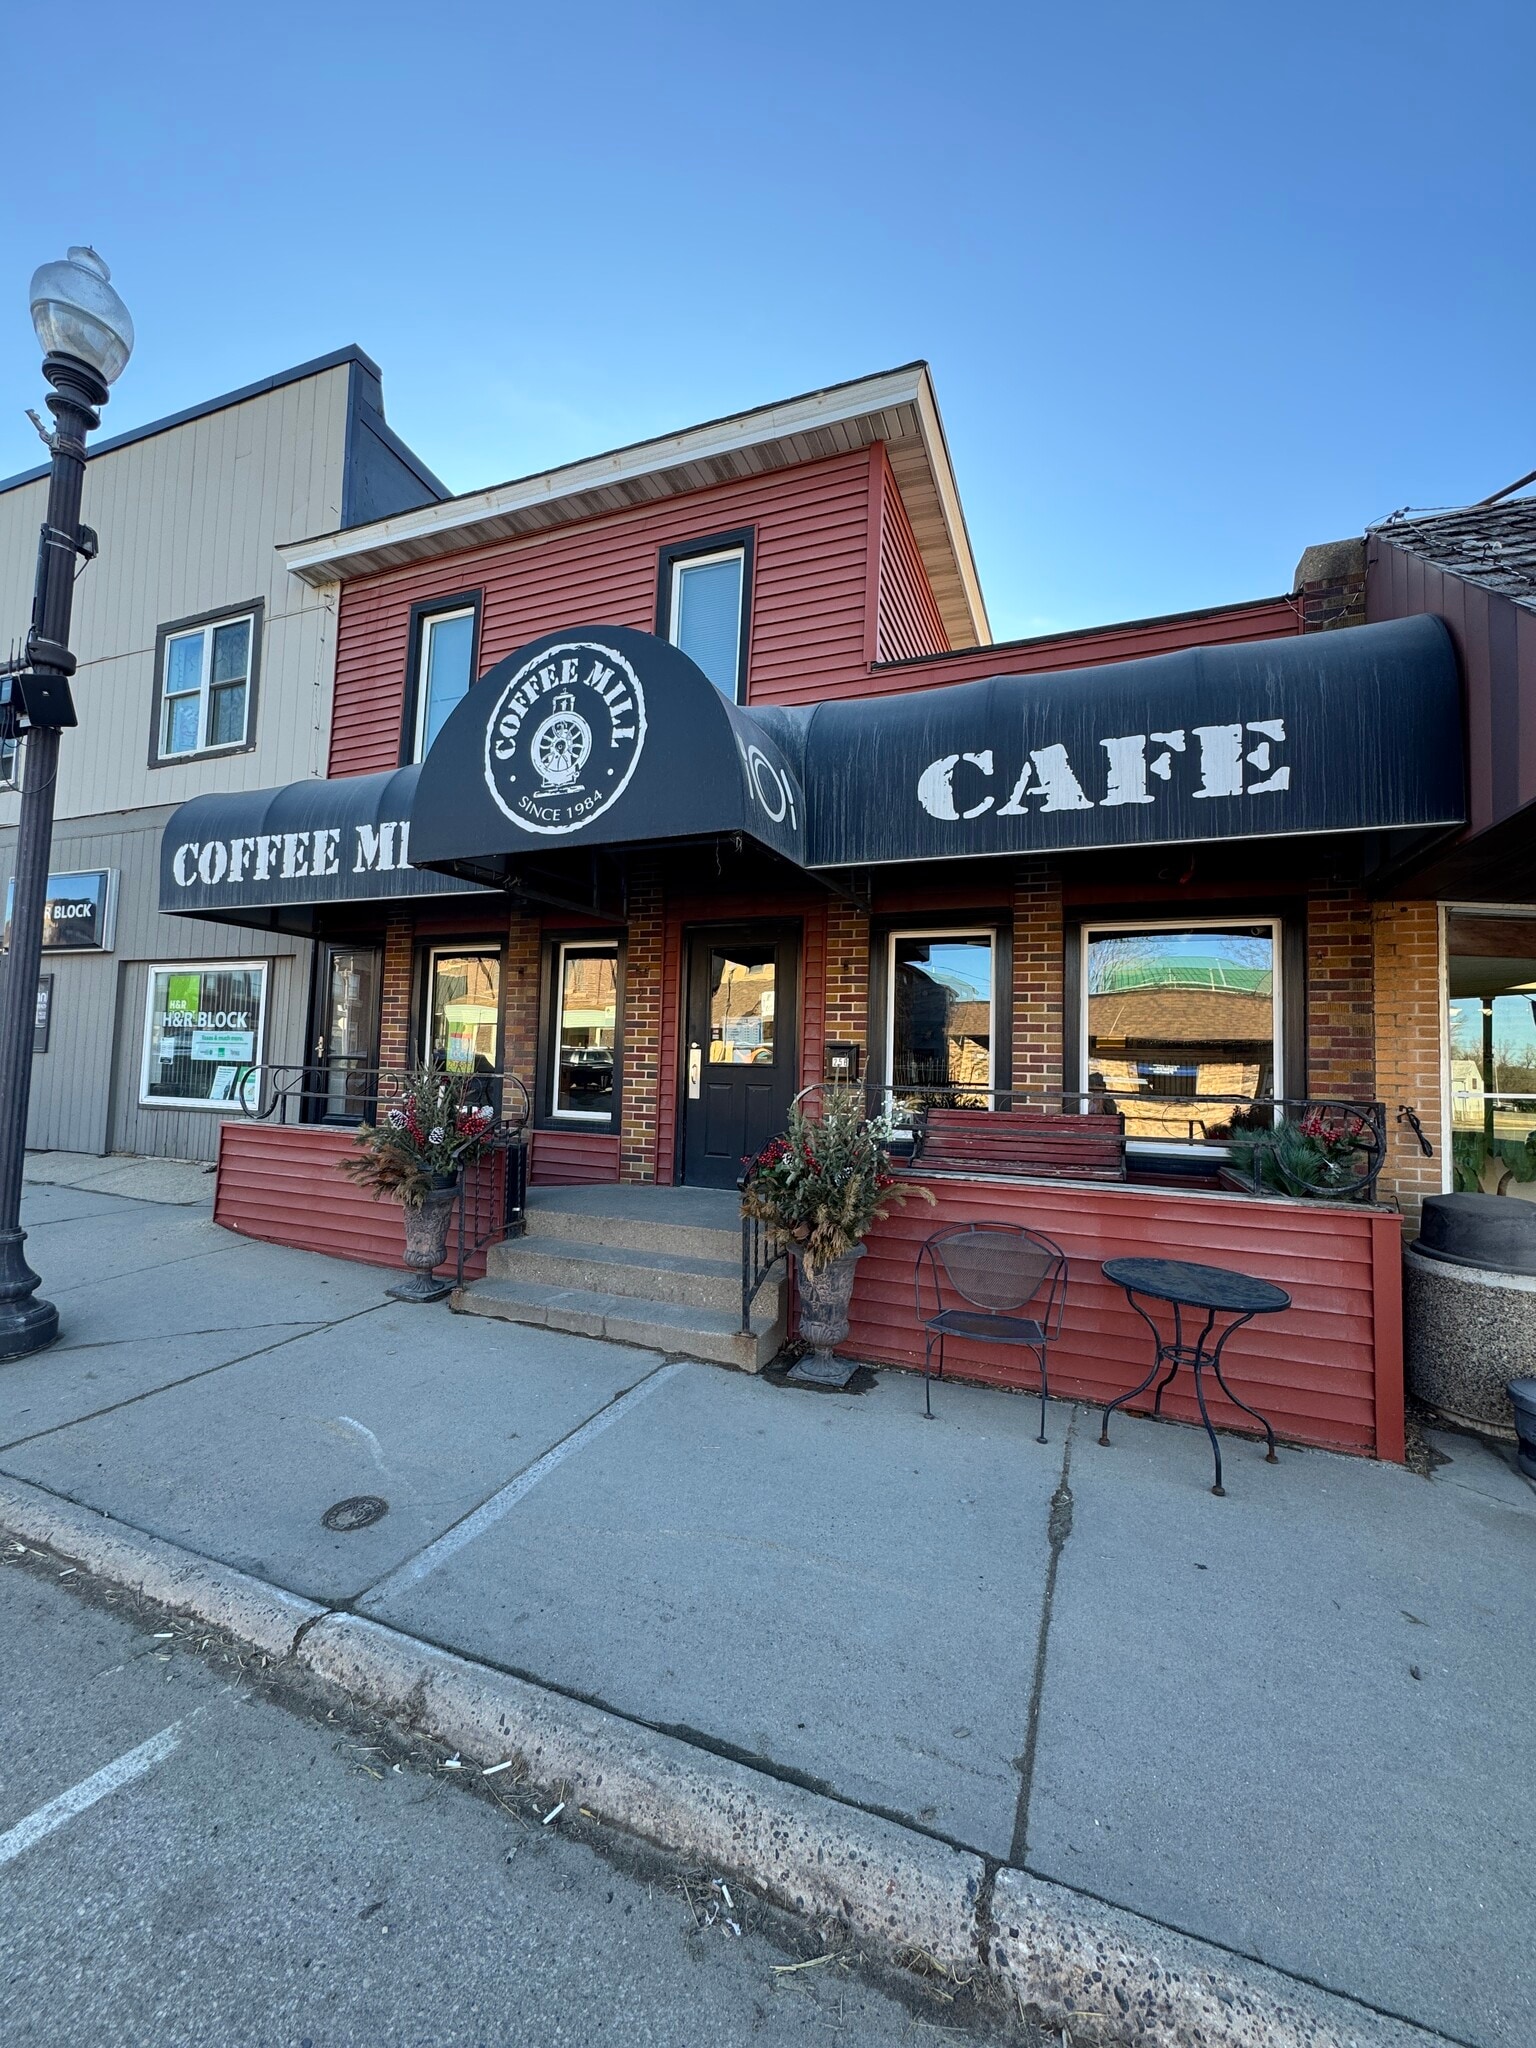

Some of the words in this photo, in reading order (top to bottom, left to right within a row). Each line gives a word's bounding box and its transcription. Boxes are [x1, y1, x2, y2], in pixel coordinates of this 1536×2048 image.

[495, 658, 579, 760] COFFEE
[583, 660, 635, 748] MILL
[917, 719, 1290, 820] CAFE
[518, 795, 561, 821] SINCE
[566, 789, 603, 819] 1984
[173, 828, 340, 887] COFFEE
[352, 821, 414, 872] MI
[54, 904, 92, 919] BLOCK
[162, 1012, 193, 1028] H&R
[198, 1012, 248, 1028] BLOCK
[169, 1000, 187, 1009] H&R
